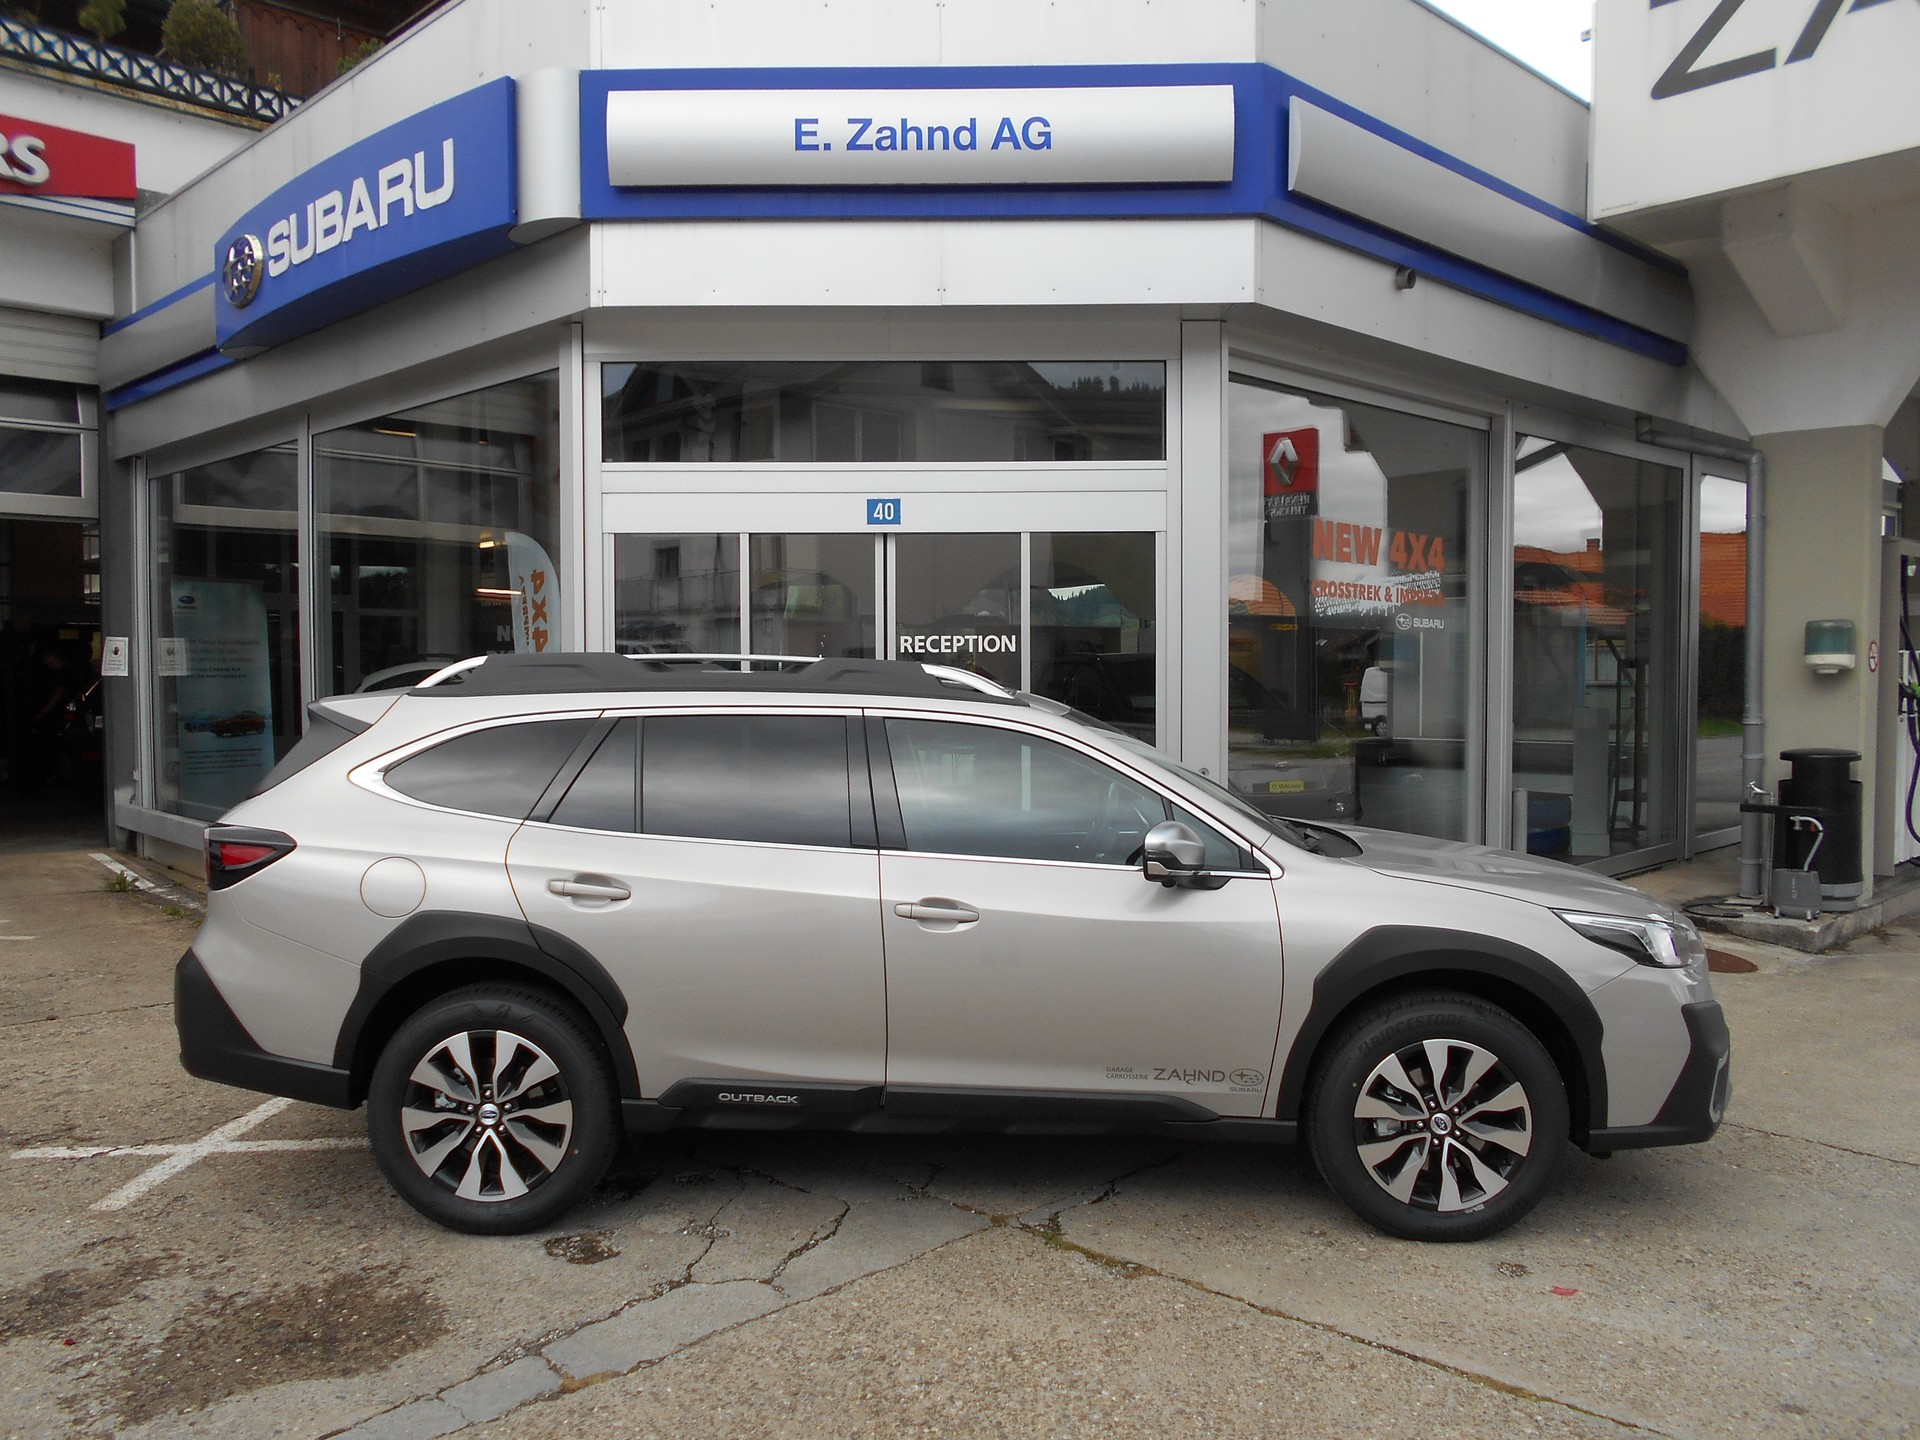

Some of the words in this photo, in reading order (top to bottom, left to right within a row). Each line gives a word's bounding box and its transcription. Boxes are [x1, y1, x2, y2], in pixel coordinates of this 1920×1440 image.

[794, 117, 832, 151] E.
[846, 117, 977, 151] Zahnd
[990, 116, 1053, 151] AG
[267, 138, 455, 278] SUBARU
[872, 501, 895, 522] 40
[1313, 519, 1382, 566] NEW
[1389, 530, 1446, 573] 4X4
[1311, 577, 1382, 602] CROSSTREK
[1384, 585, 1394, 603] &
[1413, 617, 1444, 629] SUBARU
[899, 634, 1017, 654] RECEPTION
[1106, 1072, 1148, 1080] CARROSSERIE
[1152, 1067, 1226, 1085] ZAHND
[717, 1092, 798, 1104] OUTBACK
